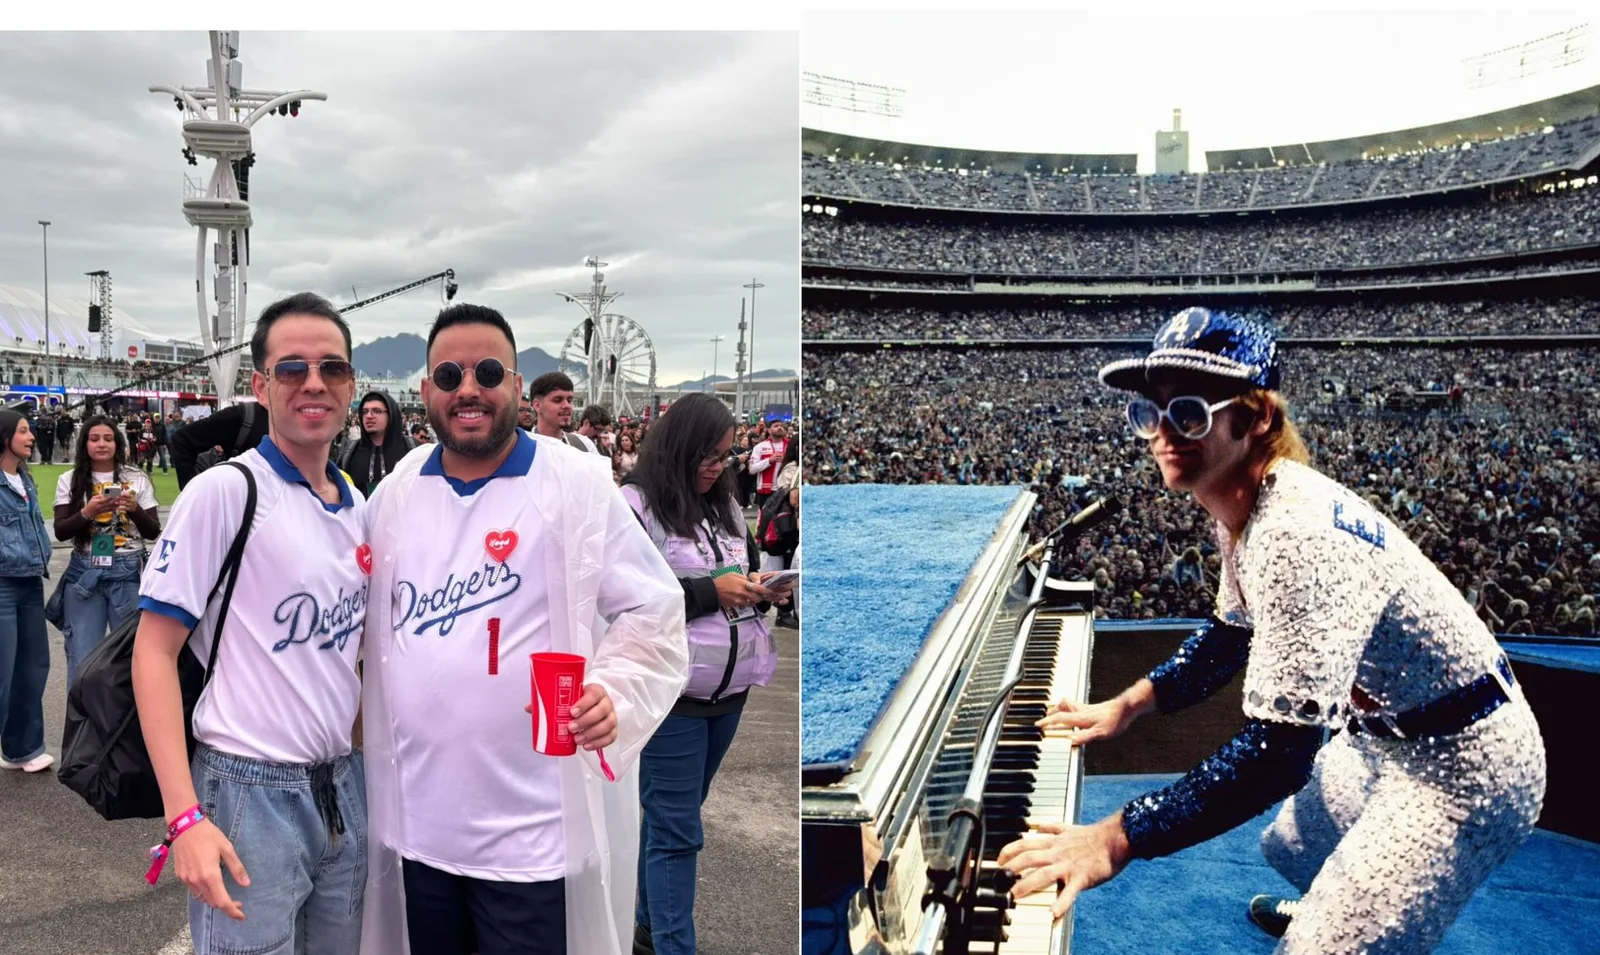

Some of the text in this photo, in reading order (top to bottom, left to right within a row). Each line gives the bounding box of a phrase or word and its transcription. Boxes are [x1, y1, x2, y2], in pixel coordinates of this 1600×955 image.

[154, 538, 177, 574] E
[272, 579, 367, 652] Dodger
[393, 559, 521, 636] Dodgers
[486, 617, 500, 676] 1
